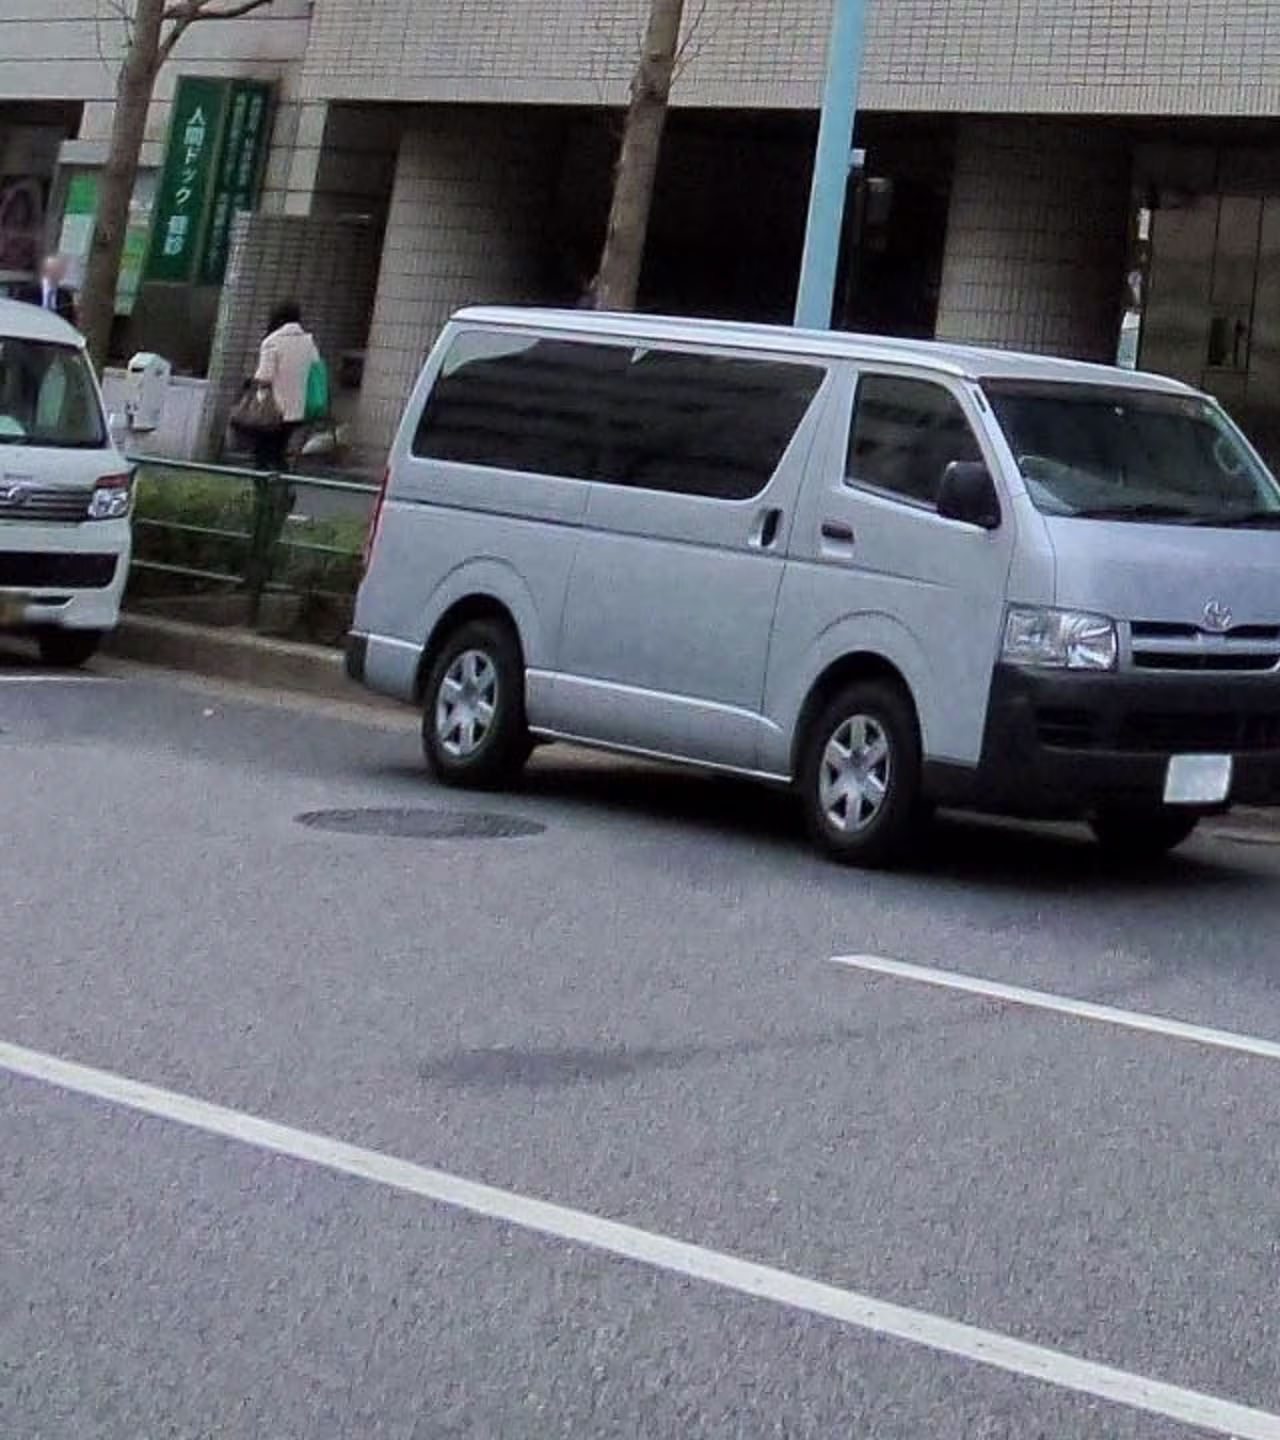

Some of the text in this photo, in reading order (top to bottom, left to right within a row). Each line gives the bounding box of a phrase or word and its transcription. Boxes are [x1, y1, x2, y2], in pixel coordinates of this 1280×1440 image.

[176, 106, 207, 206] 人間ドック
